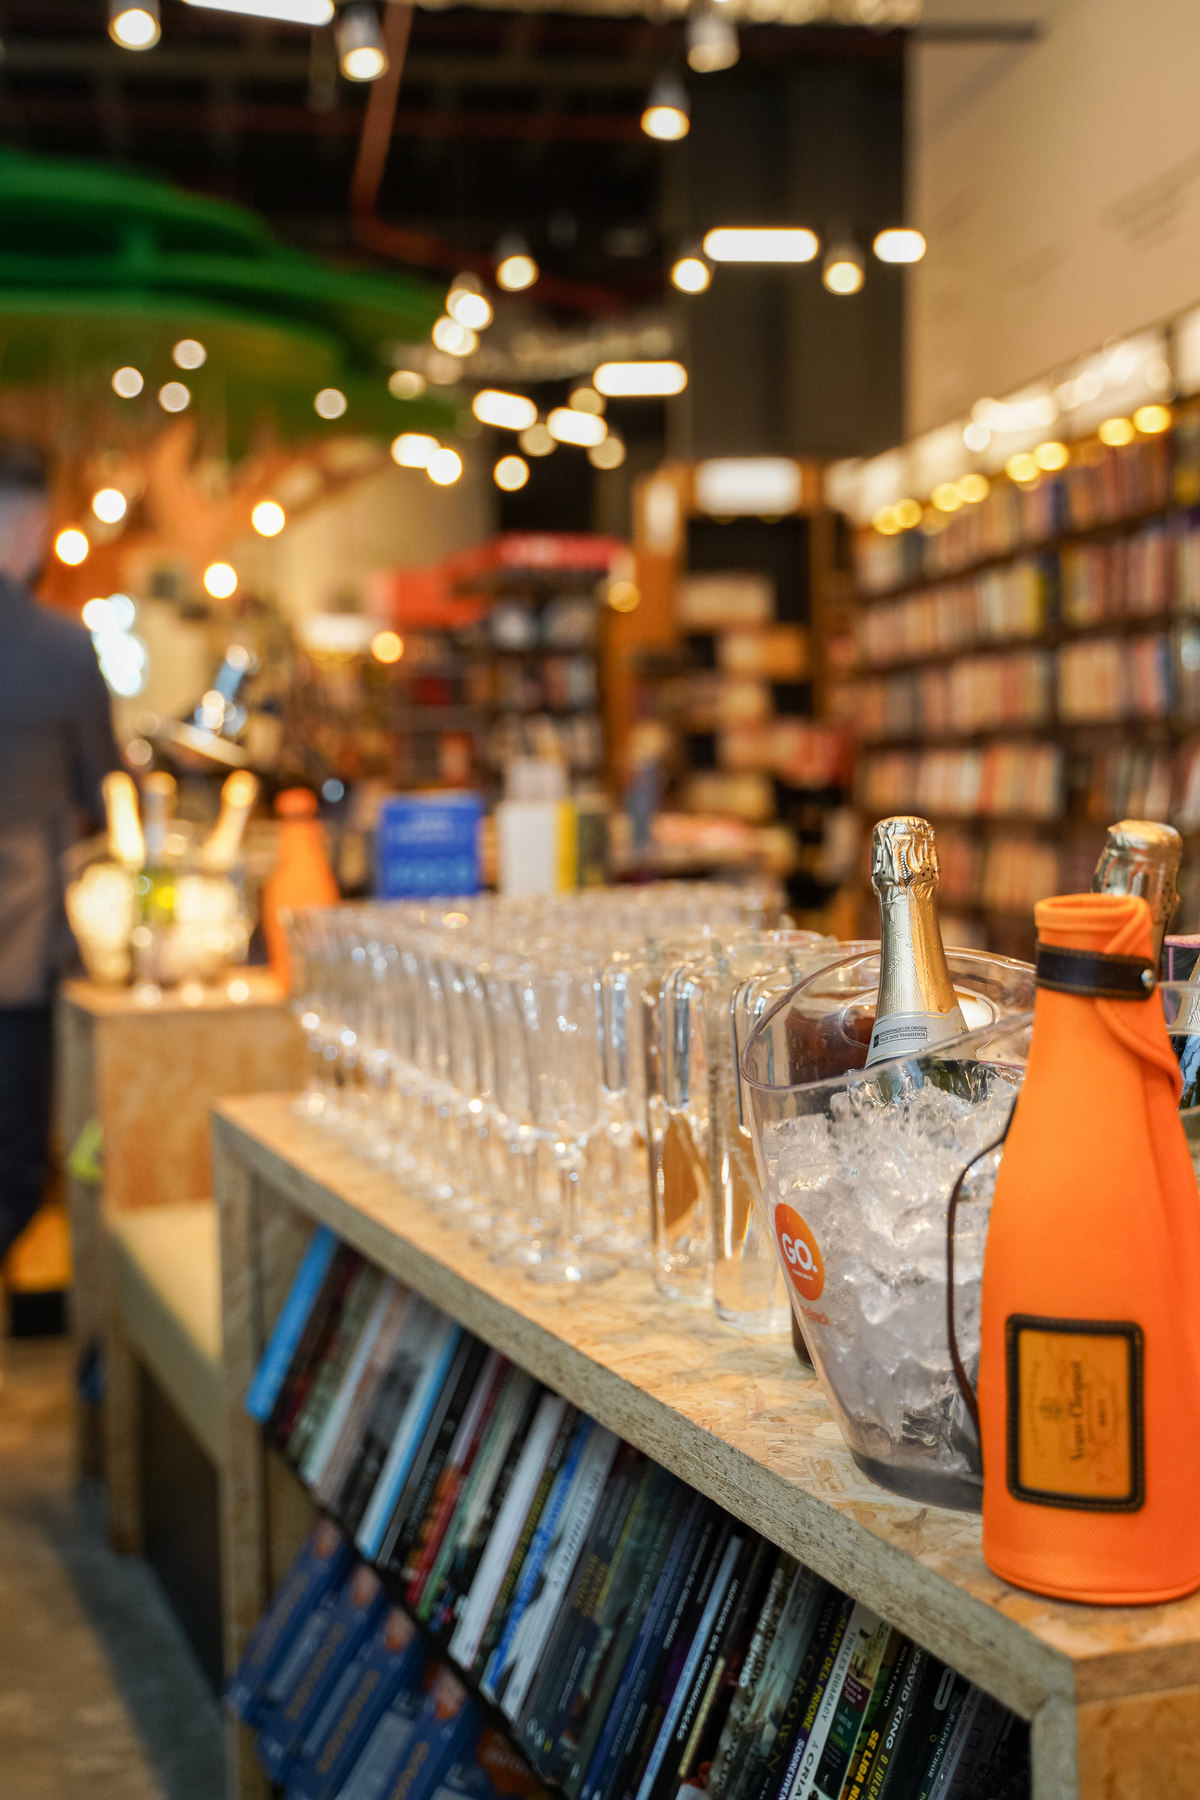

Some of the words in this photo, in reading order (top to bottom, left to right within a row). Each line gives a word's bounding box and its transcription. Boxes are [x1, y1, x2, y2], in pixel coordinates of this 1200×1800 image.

[782, 1232, 818, 1273] GO.
[828, 1615, 847, 1655] MARY
[837, 1631, 856, 1671] THALES
[820, 1672, 842, 1721] GUARACY
[883, 1683, 894, 1706] NETO
[900, 1652, 921, 1701] DAVID
[766, 1654, 815, 1773] CROWN
[802, 1684, 823, 1732] PRIORE
[885, 1705, 904, 1749] KING
[867, 1729, 879, 1749] SE
[855, 1749, 872, 1782] LIGA
[927, 1745, 943, 1777] SCHOR
